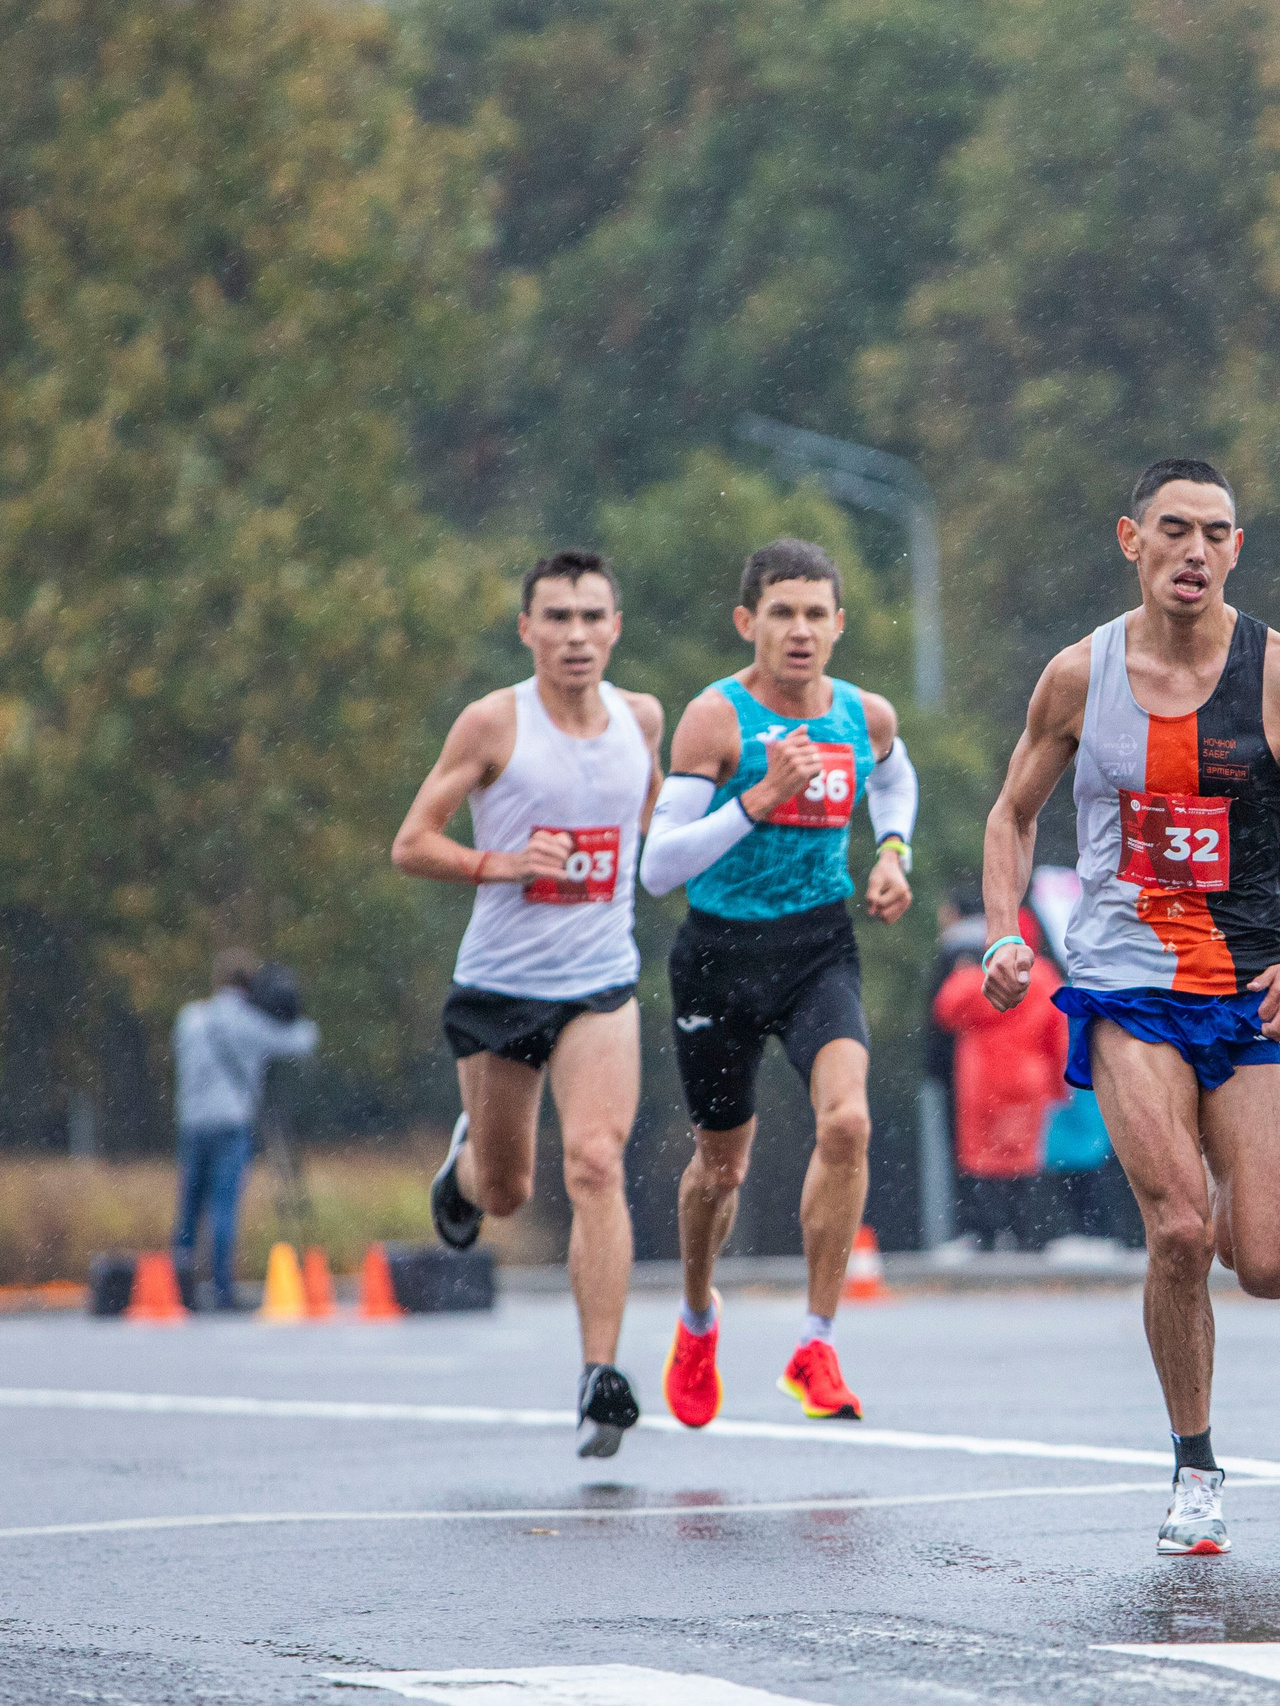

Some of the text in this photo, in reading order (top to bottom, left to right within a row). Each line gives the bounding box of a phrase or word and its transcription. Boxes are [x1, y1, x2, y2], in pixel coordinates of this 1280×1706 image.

[1202, 748, 1230, 759] ЗАБЕГ
[1203, 737, 1237, 749] НОЧНОЙ
[805, 769, 849, 803] 36
[1163, 827, 1219, 862] 32
[566, 851, 614, 882] 03
